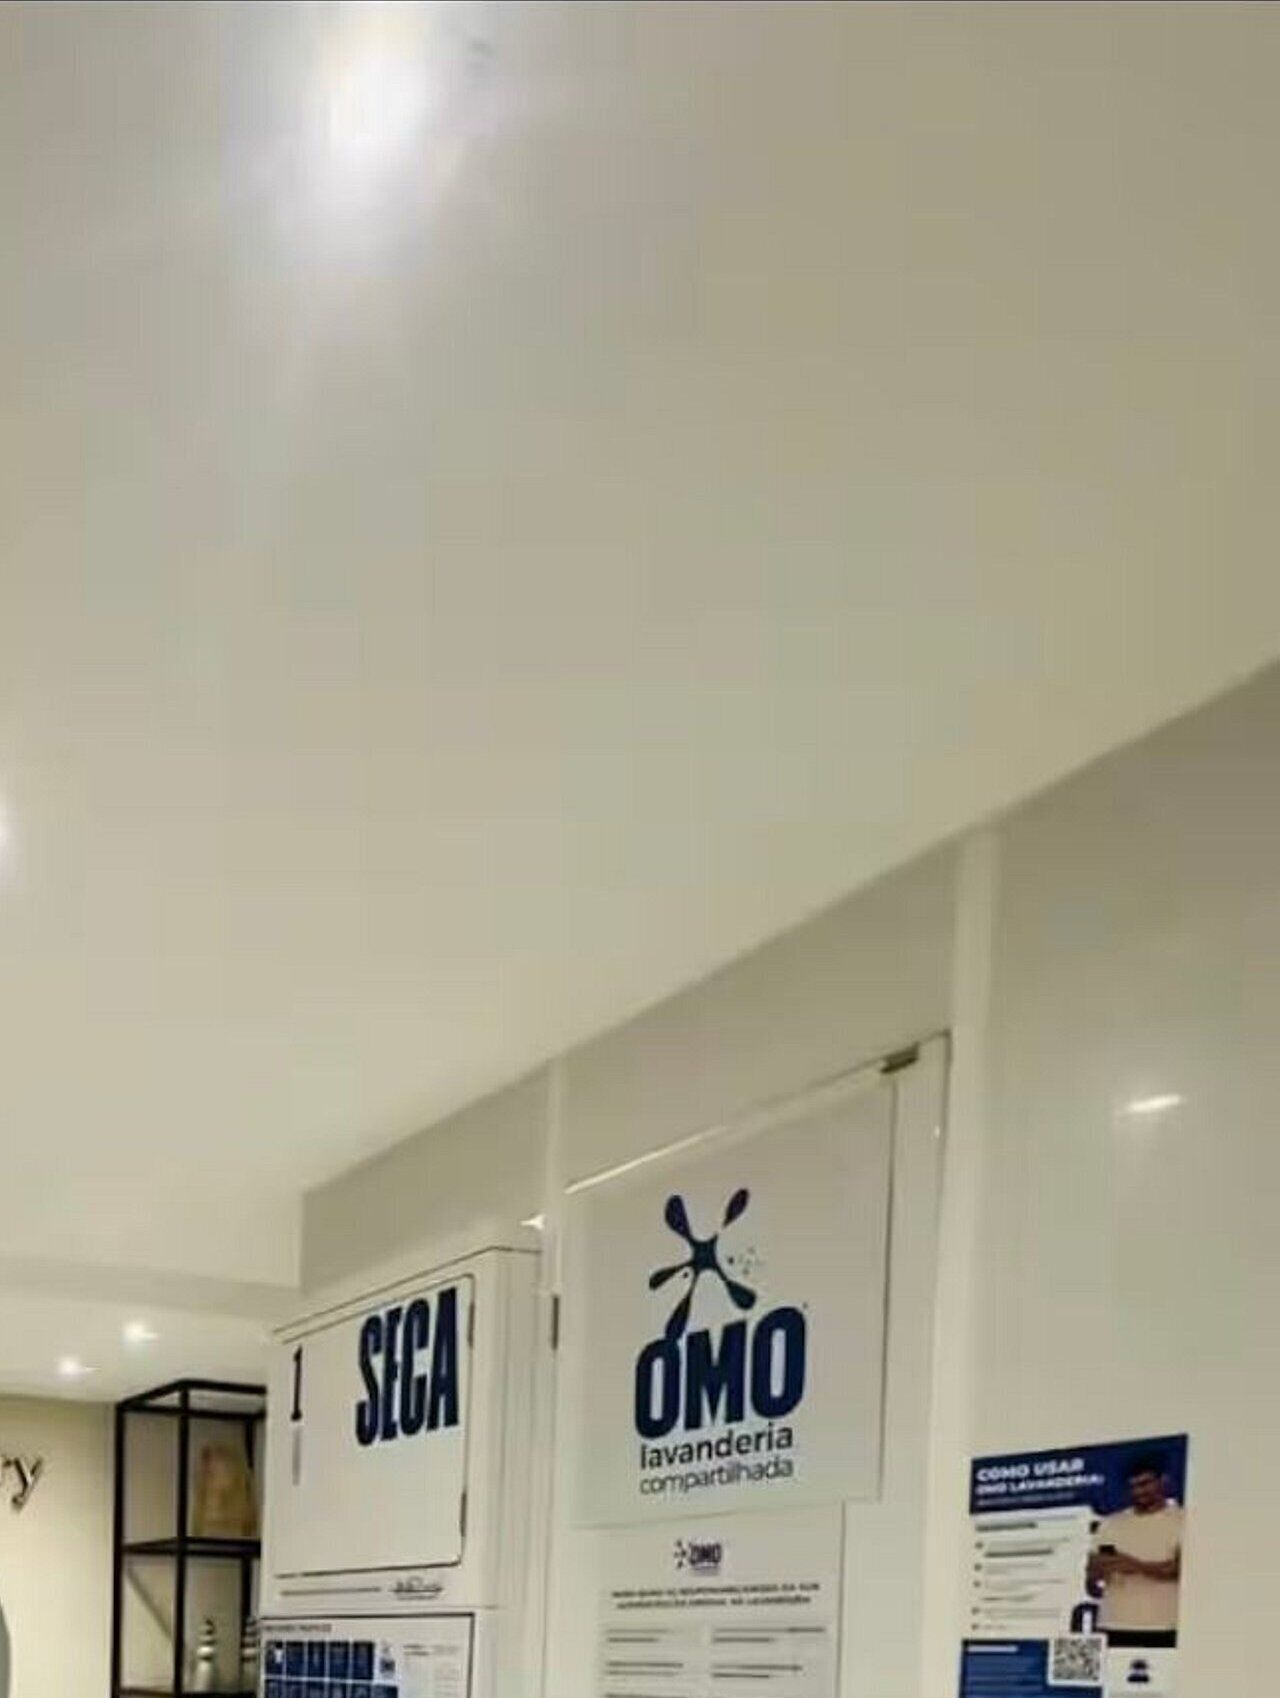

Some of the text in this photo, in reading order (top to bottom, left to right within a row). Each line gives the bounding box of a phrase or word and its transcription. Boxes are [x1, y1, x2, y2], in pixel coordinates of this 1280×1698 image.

[355, 1286, 460, 1448] SECA
[634, 1306, 807, 1439] OMO
[639, 1421, 794, 1470] lavanderia
[976, 1457, 1085, 1482] COMO USAR
[639, 1454, 794, 1496] compartilhada
